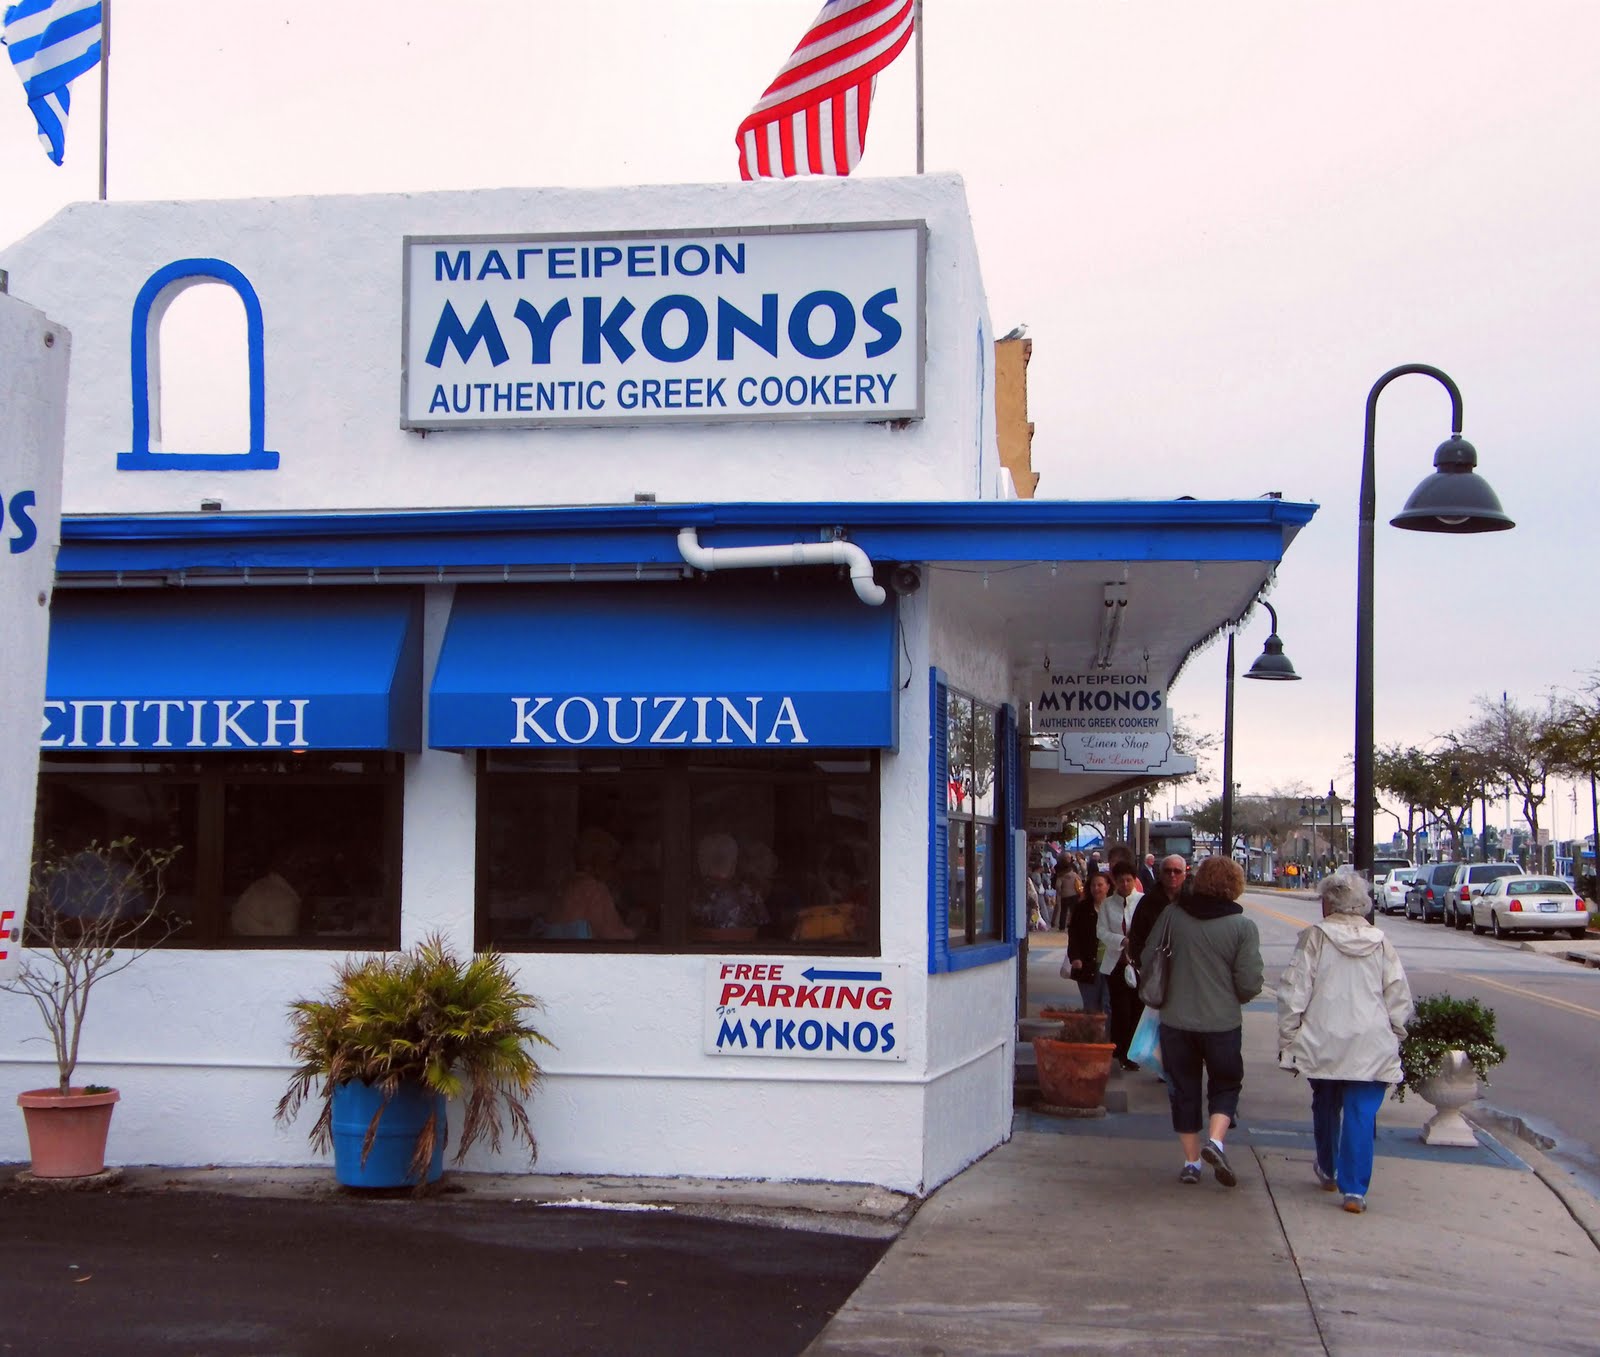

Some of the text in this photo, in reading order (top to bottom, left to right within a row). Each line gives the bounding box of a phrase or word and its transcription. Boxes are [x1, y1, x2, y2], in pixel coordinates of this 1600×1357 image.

[435, 243, 746, 281] ΜΑΓΕΙΡΕΙΟΝ
[425, 287, 902, 368] MYKONOS
[429, 374, 897, 413] AUTHENTIC GREEK COOKERY
[0, 490, 37, 554] S
[1038, 690, 1162, 711] MYKONOS
[510, 696, 809, 744] KOUZINA
[1040, 717, 1159, 728] AUTHENTIC GREEK COOKERY
[1081, 735, 1149, 752] Linen Shop
[1108, 753, 1145, 765] Linens
[720, 964, 784, 981] FREE
[719, 984, 893, 1010] PARKING
[716, 1005, 736, 1019] For
[716, 1019, 896, 1053] MYKONOS
